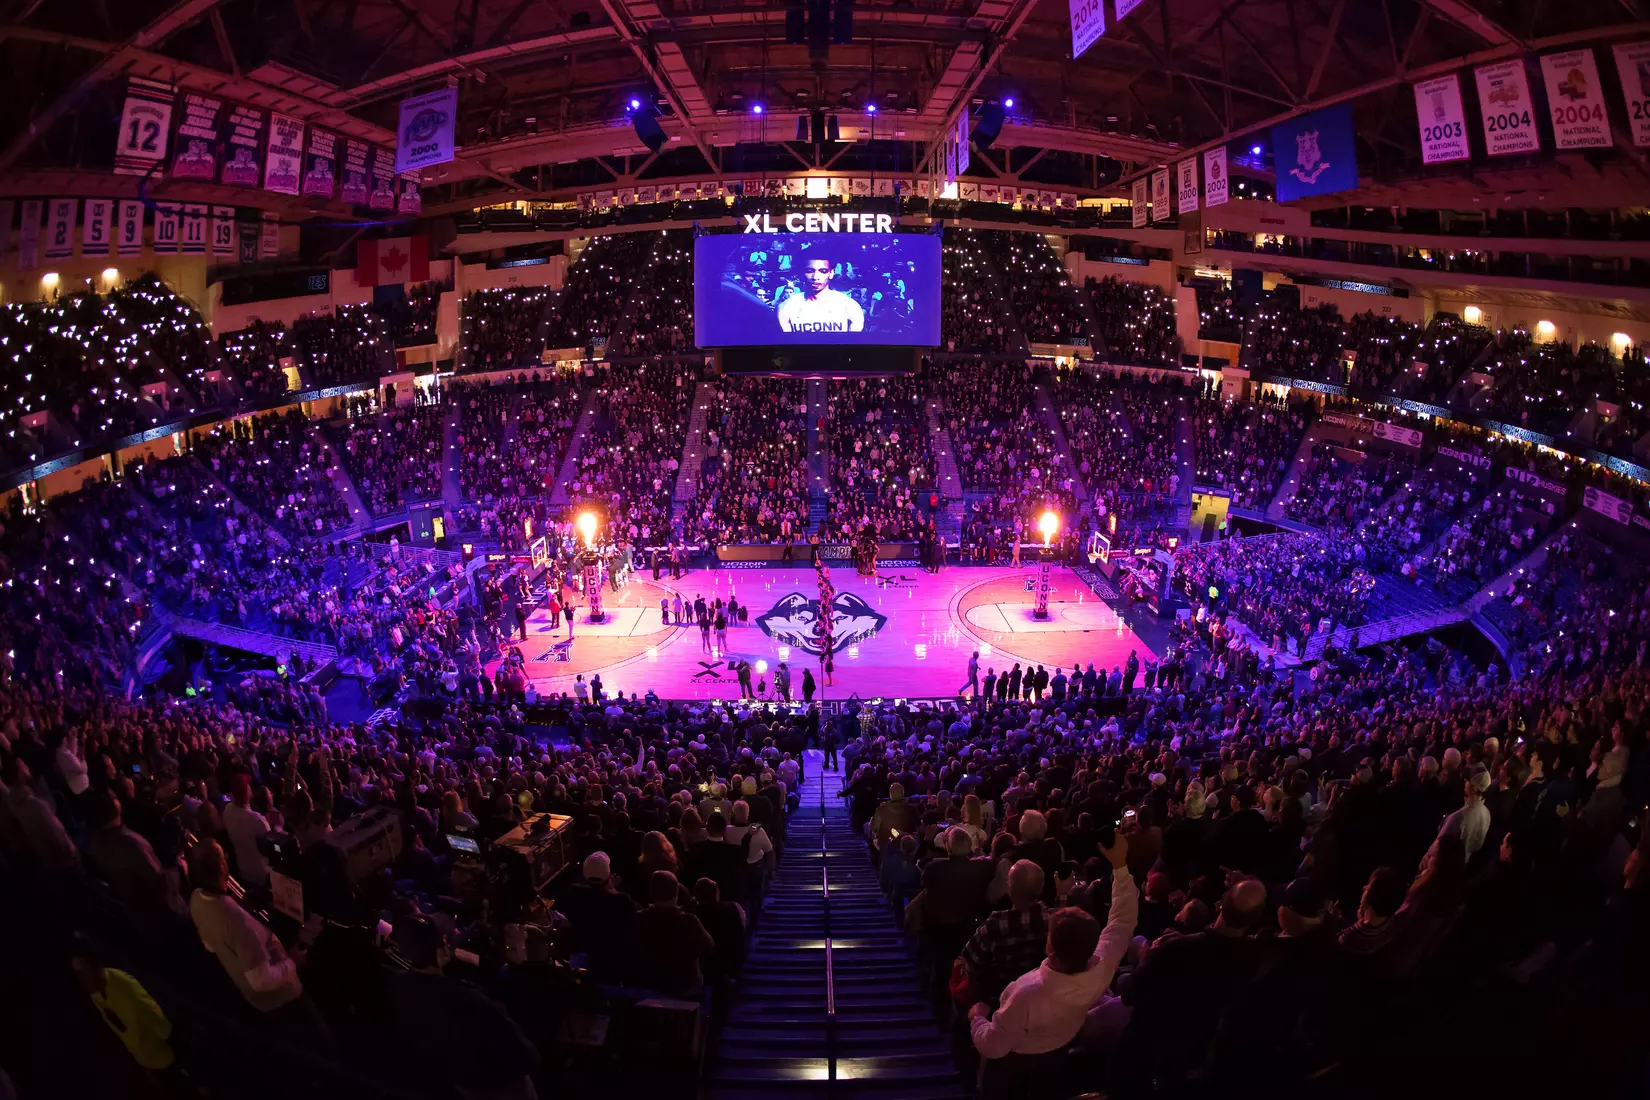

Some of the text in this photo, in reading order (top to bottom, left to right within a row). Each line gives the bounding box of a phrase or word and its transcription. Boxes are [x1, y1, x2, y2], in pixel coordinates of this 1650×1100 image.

[1074, 0, 1098, 31] 2014
[1075, 25, 1102, 53] CHAMPIONS
[1487, 110, 1531, 132] 2004
[1554, 104, 1603, 124] 2004
[127, 118, 160, 153] 12
[1424, 121, 1462, 142] 2003
[1494, 131, 1528, 141] NATIONAL
[1563, 126, 1602, 135] NATIONAL
[411, 143, 438, 157] 2000
[1428, 141, 1460, 150] NATIONAL
[1492, 141, 1533, 152] CHAMPIONS
[1561, 137, 1607, 146] CHAMPIONS
[1428, 149, 1464, 160] CHAMPIONS
[1180, 187, 1197, 201] 2000
[1207, 178, 1226, 193] 2002
[91, 219, 102, 241] 5
[125, 219, 135, 242] 9
[158, 221, 175, 240] 10
[188, 222, 201, 241] 11
[743, 213, 892, 233] XL CENTER
[55, 221, 67, 245] 2
[216, 224, 231, 244] 19
[793, 321, 843, 332] UCONN
[1322, 415, 1346, 425] UCONN
[1539, 480, 1567, 496] HUSKIES
[588, 568, 599, 612] UCONN
[1039, 565, 1049, 610] UCONN
